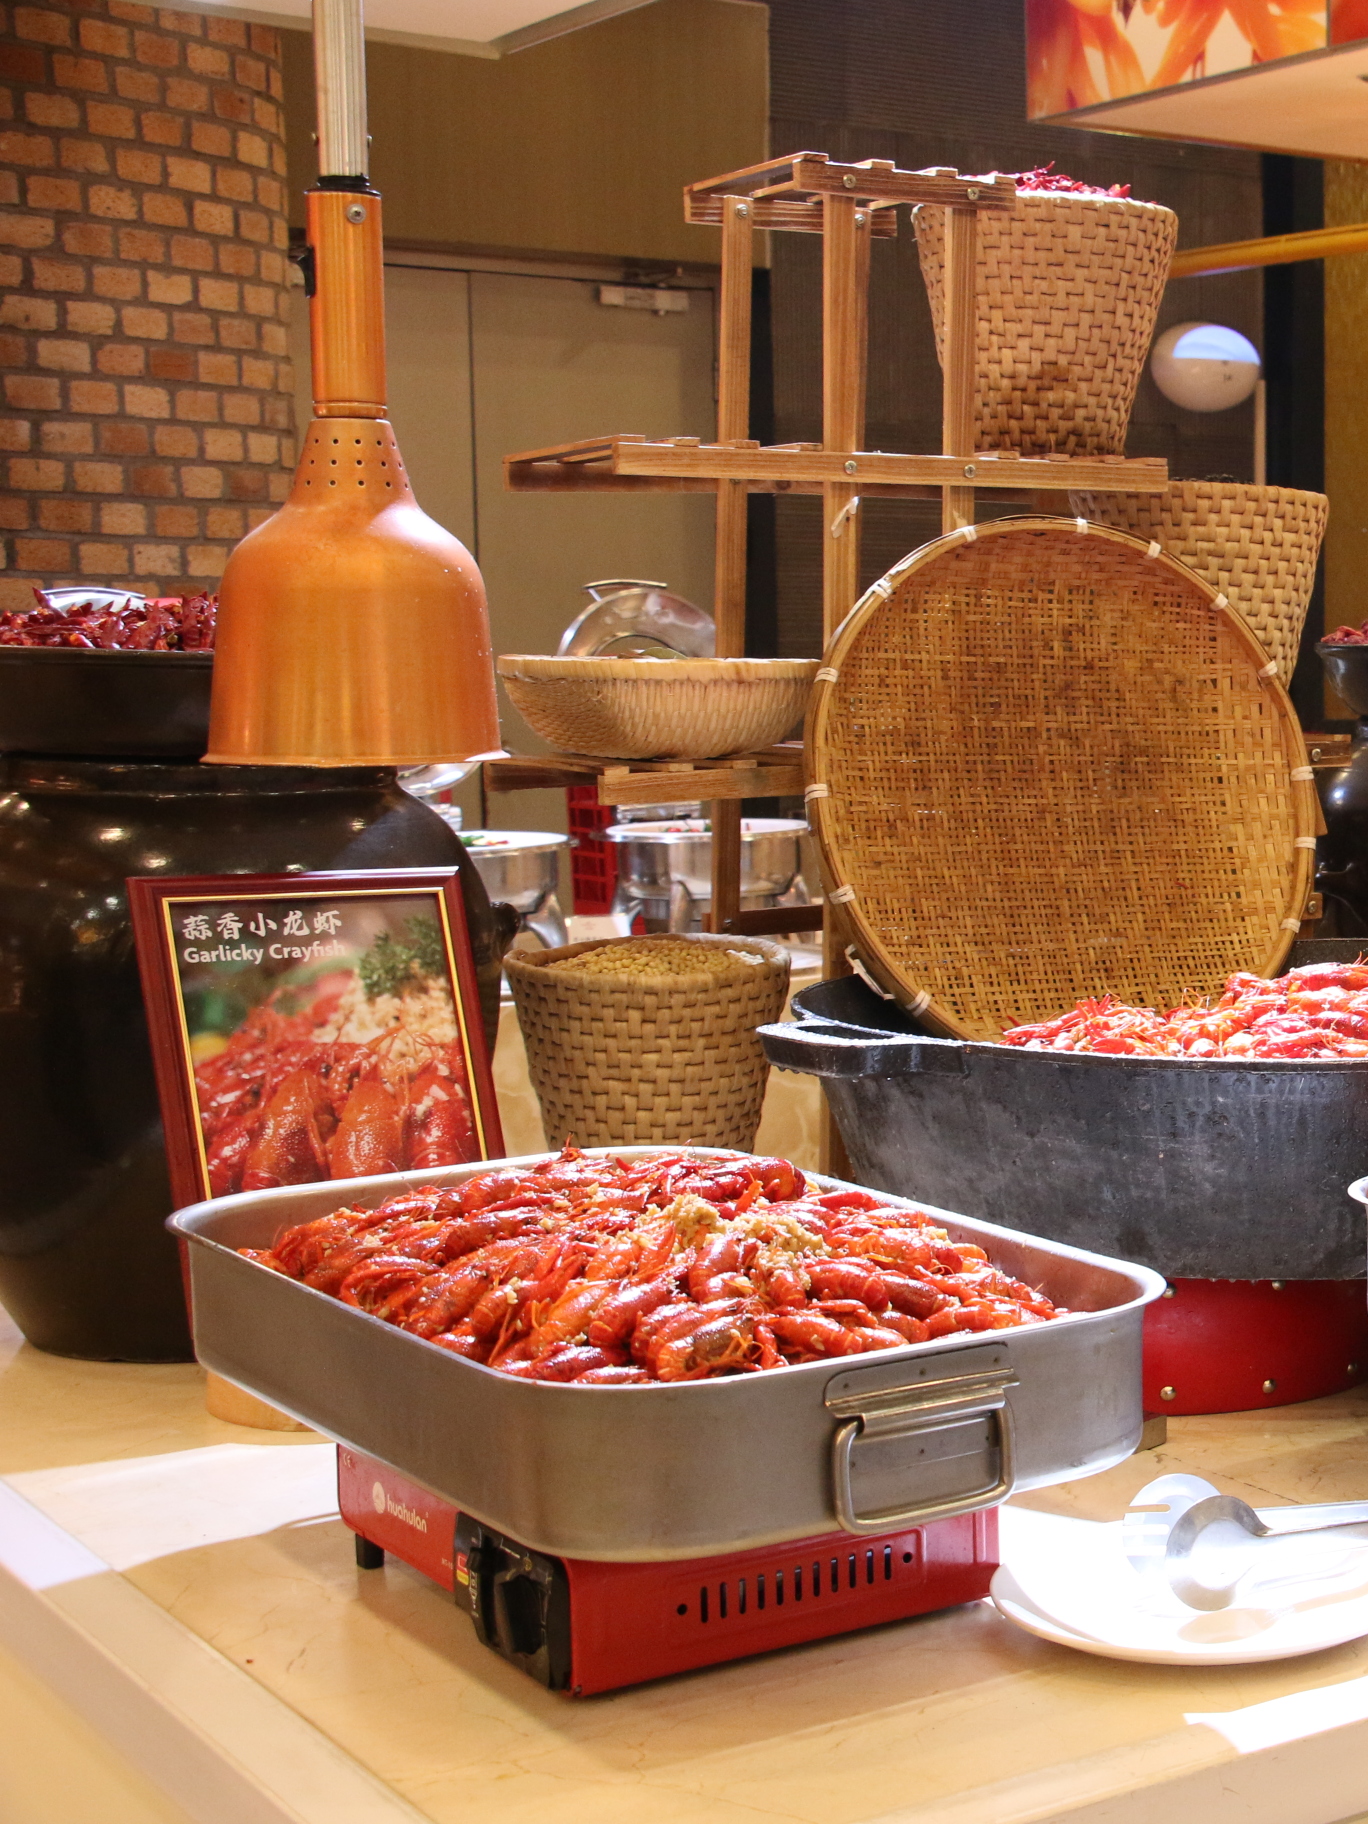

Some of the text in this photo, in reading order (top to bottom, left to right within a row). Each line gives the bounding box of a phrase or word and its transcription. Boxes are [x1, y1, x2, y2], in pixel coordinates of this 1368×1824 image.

[182, 910, 342, 940] 蒜香小龙虾
[184, 940, 347, 965] Garlicky Crayfish
[387, 1494, 427, 1533] huahulan
